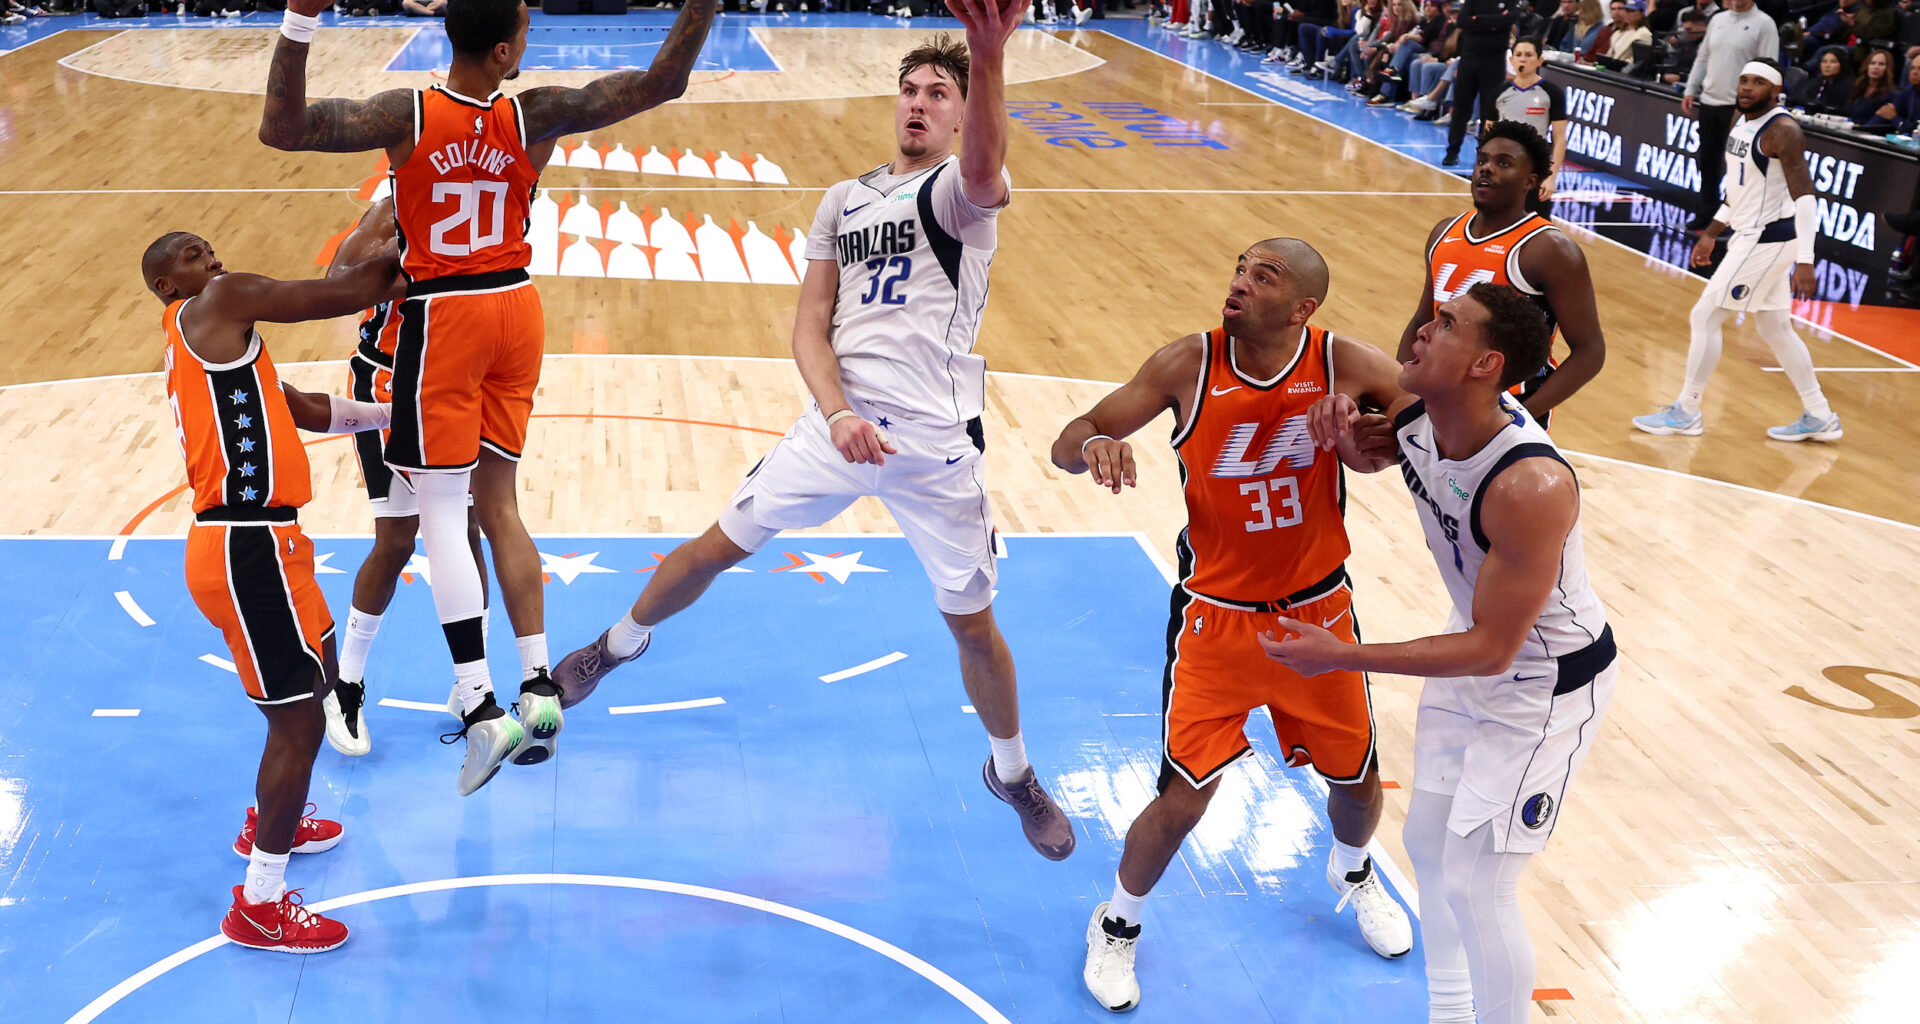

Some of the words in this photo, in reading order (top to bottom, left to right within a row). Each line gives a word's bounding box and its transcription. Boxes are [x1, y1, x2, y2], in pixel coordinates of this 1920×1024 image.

[1566, 86, 1615, 126] VISIT
[1547, 121, 1622, 166] ANDA
[1666, 113, 1700, 153] VIS
[1635, 143, 1702, 193] RWAN
[1739, 161, 1745, 186] 1
[1804, 150, 1864, 199] ISIT
[430, 180, 509, 256] 20
[838, 219, 916, 268] DALLAS
[861, 256, 912, 305] 32
[1288, 386, 1322, 394] RWANDA
[1209, 414, 1316, 478] LA
[1239, 476, 1303, 532] 33
